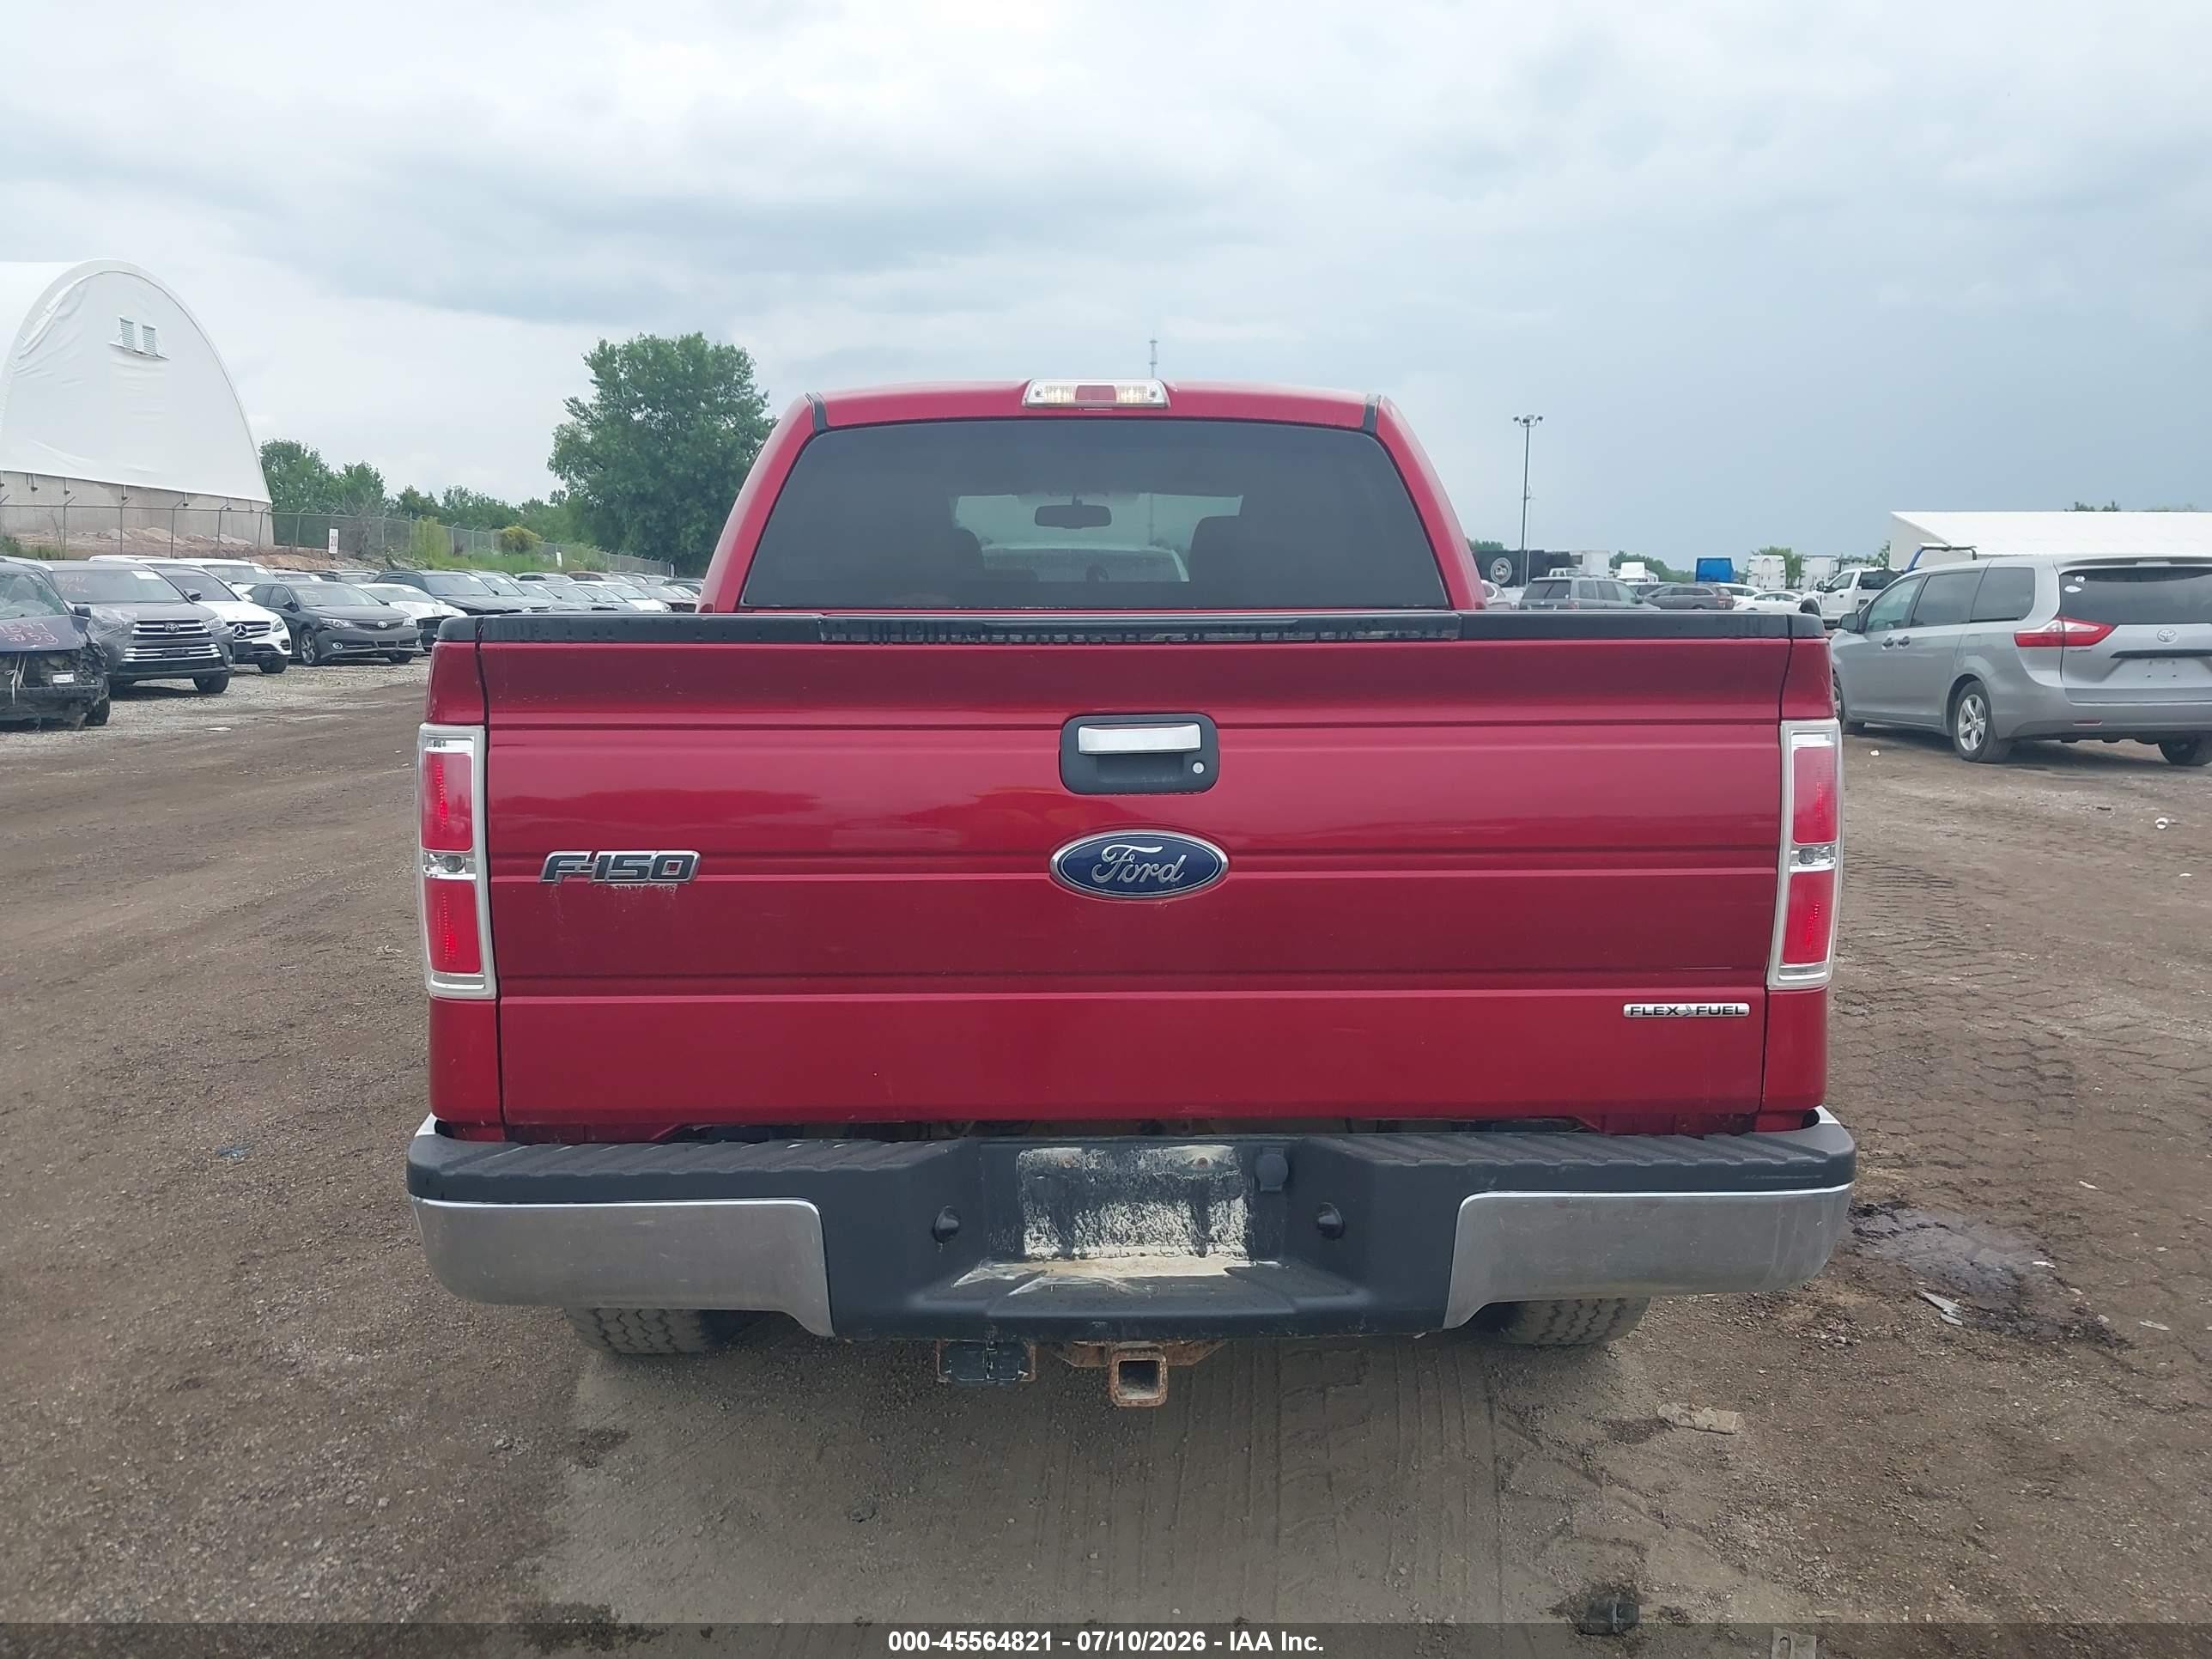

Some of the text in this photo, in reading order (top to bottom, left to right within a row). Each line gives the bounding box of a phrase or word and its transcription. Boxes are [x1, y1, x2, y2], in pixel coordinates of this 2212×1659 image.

[539, 850, 702, 884] F-150
[1091, 843, 1187, 884] Ford
[1630, 1006, 1747, 1017] FLEX FUEL
